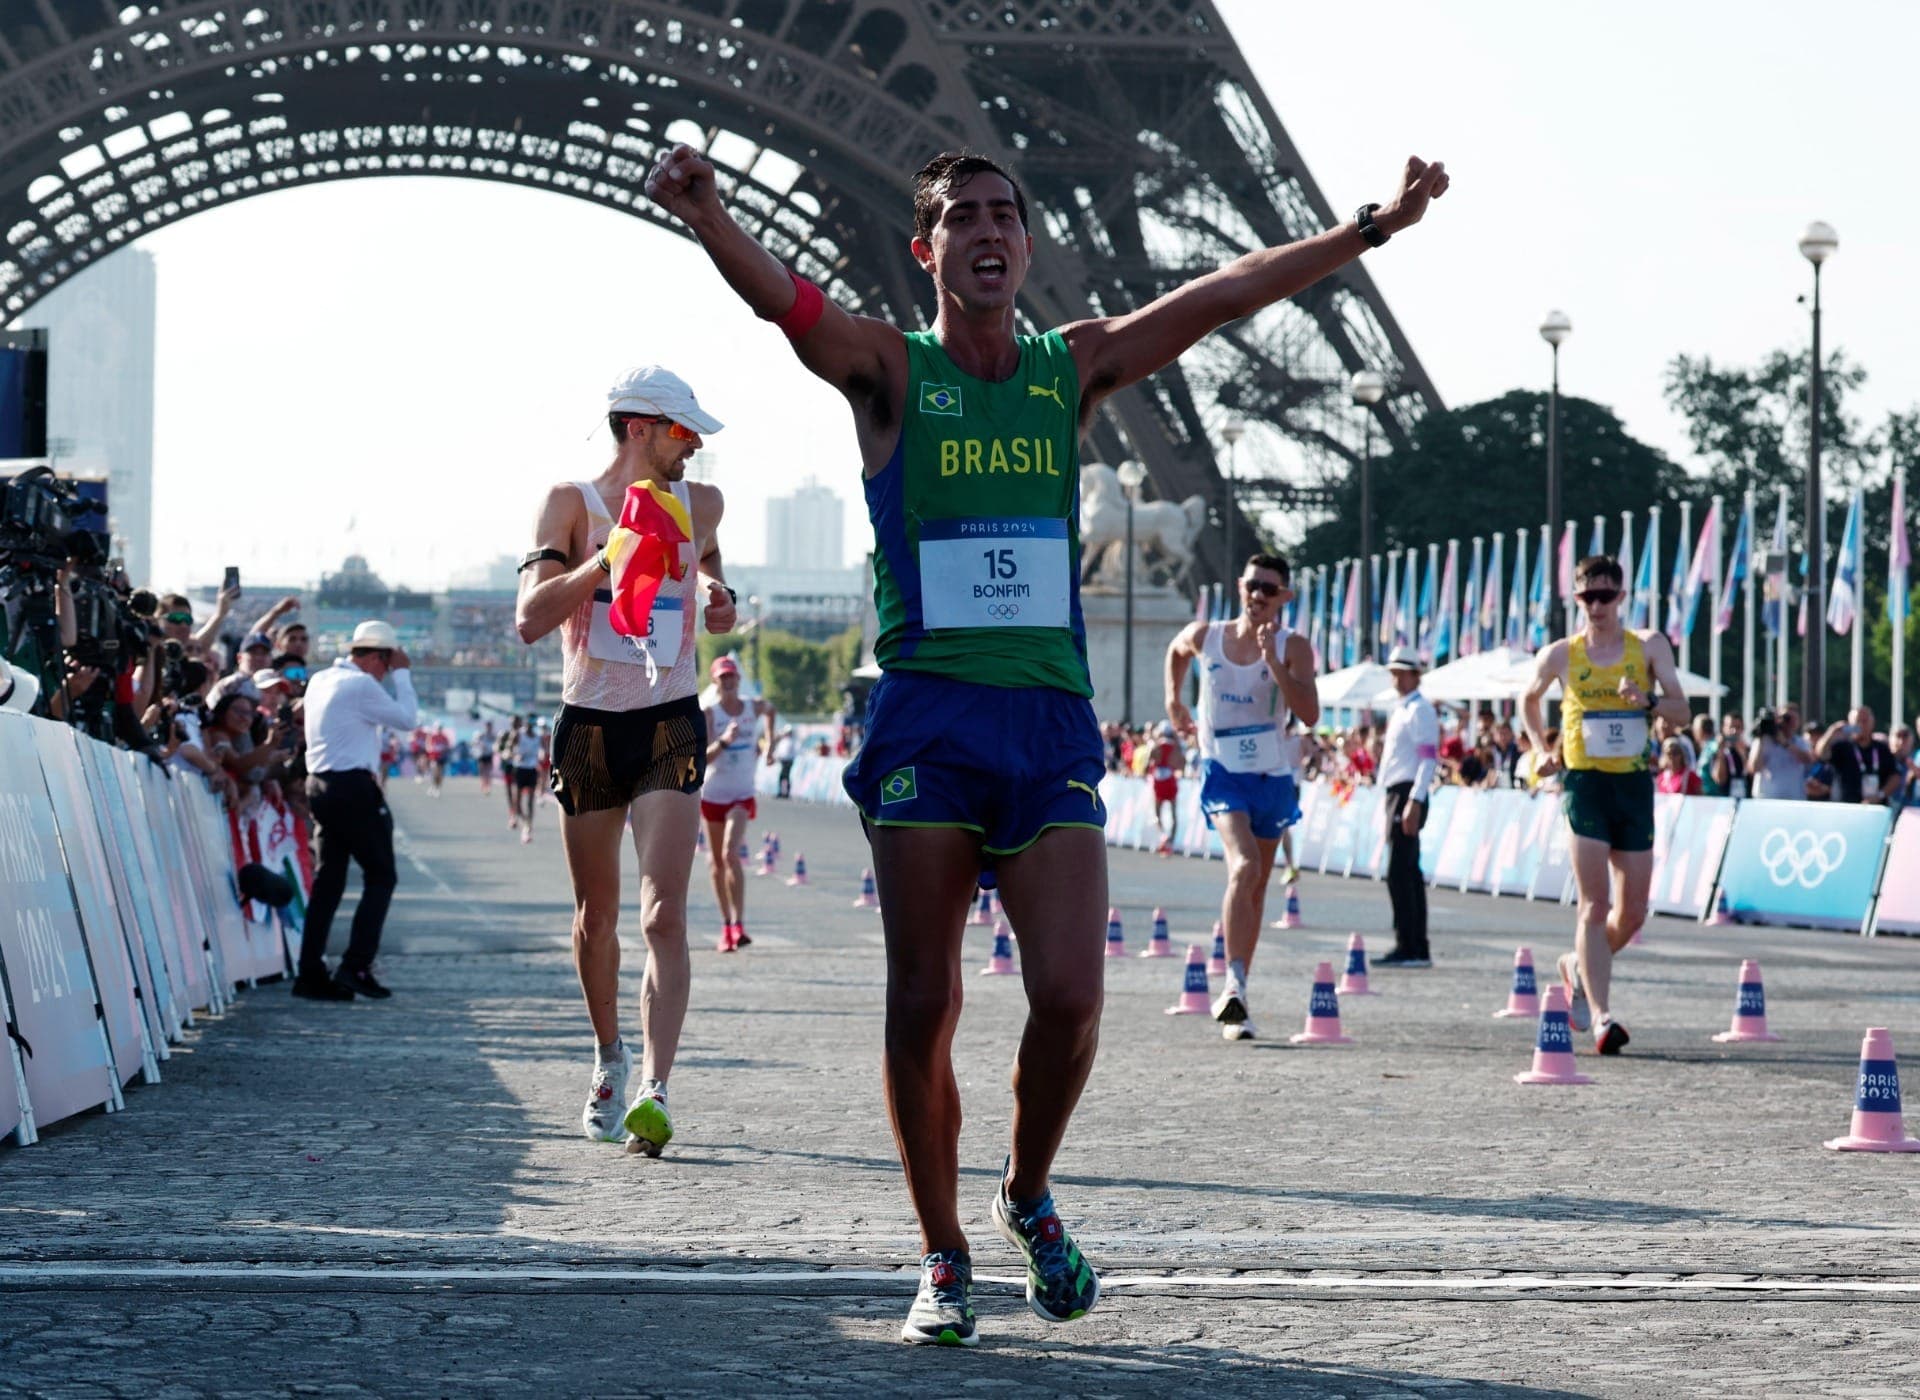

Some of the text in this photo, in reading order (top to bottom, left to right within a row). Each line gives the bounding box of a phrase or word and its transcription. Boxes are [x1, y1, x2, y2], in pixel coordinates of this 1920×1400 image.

[941, 438, 1060, 476] BRASIL
[961, 524, 1035, 533] PARIS 2024
[984, 549, 1017, 579] 15
[974, 584, 1030, 598] BONFIM
[1220, 693, 1254, 704] ITALIA
[1608, 723, 1624, 736] 12
[1239, 738, 1257, 753] 55
[16, 908, 71, 1003] 2024
[1861, 1073, 1897, 1087] PARIS
[1861, 1087, 1898, 1099] 2024
